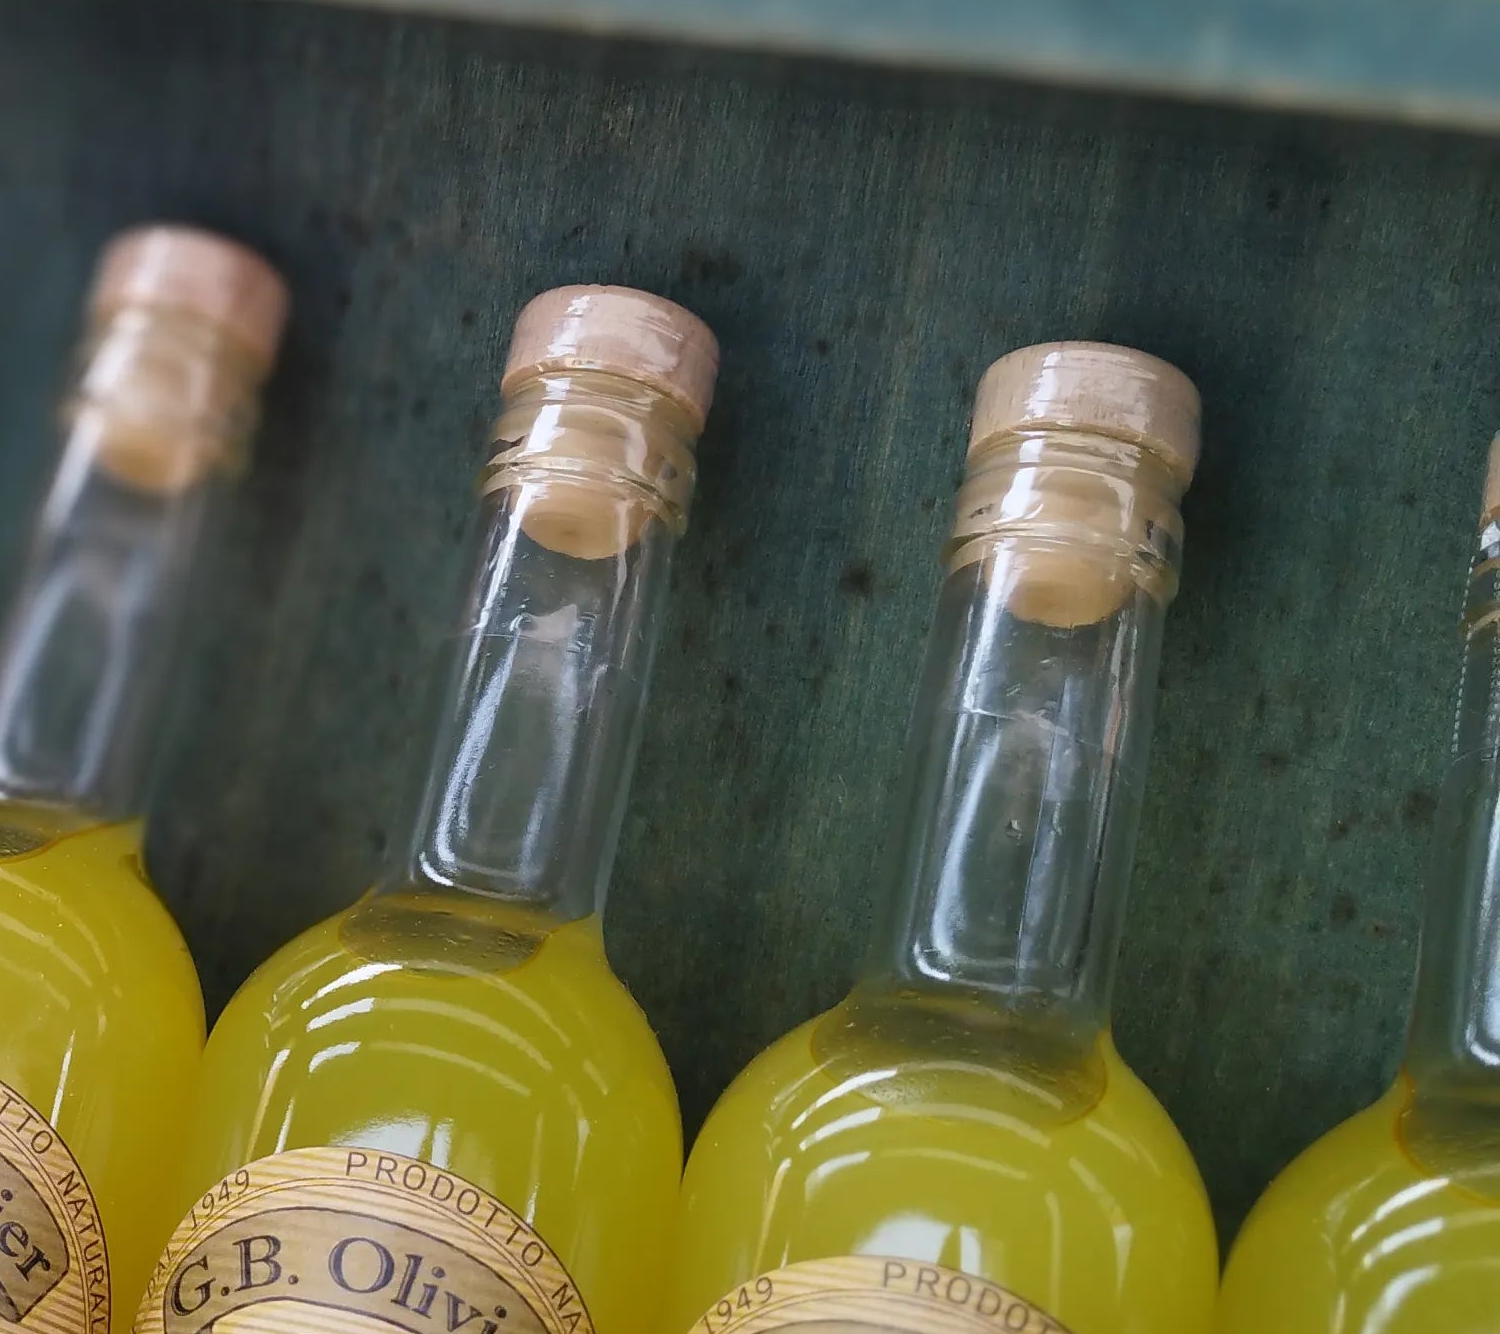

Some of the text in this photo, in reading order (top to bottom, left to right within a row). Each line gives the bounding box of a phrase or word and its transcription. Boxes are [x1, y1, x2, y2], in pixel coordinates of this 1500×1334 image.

[189, 1168, 250, 1232] 1949
[345, 1151, 546, 1268] PRODOTTO
[171, 1234, 300, 1318] G.B.
